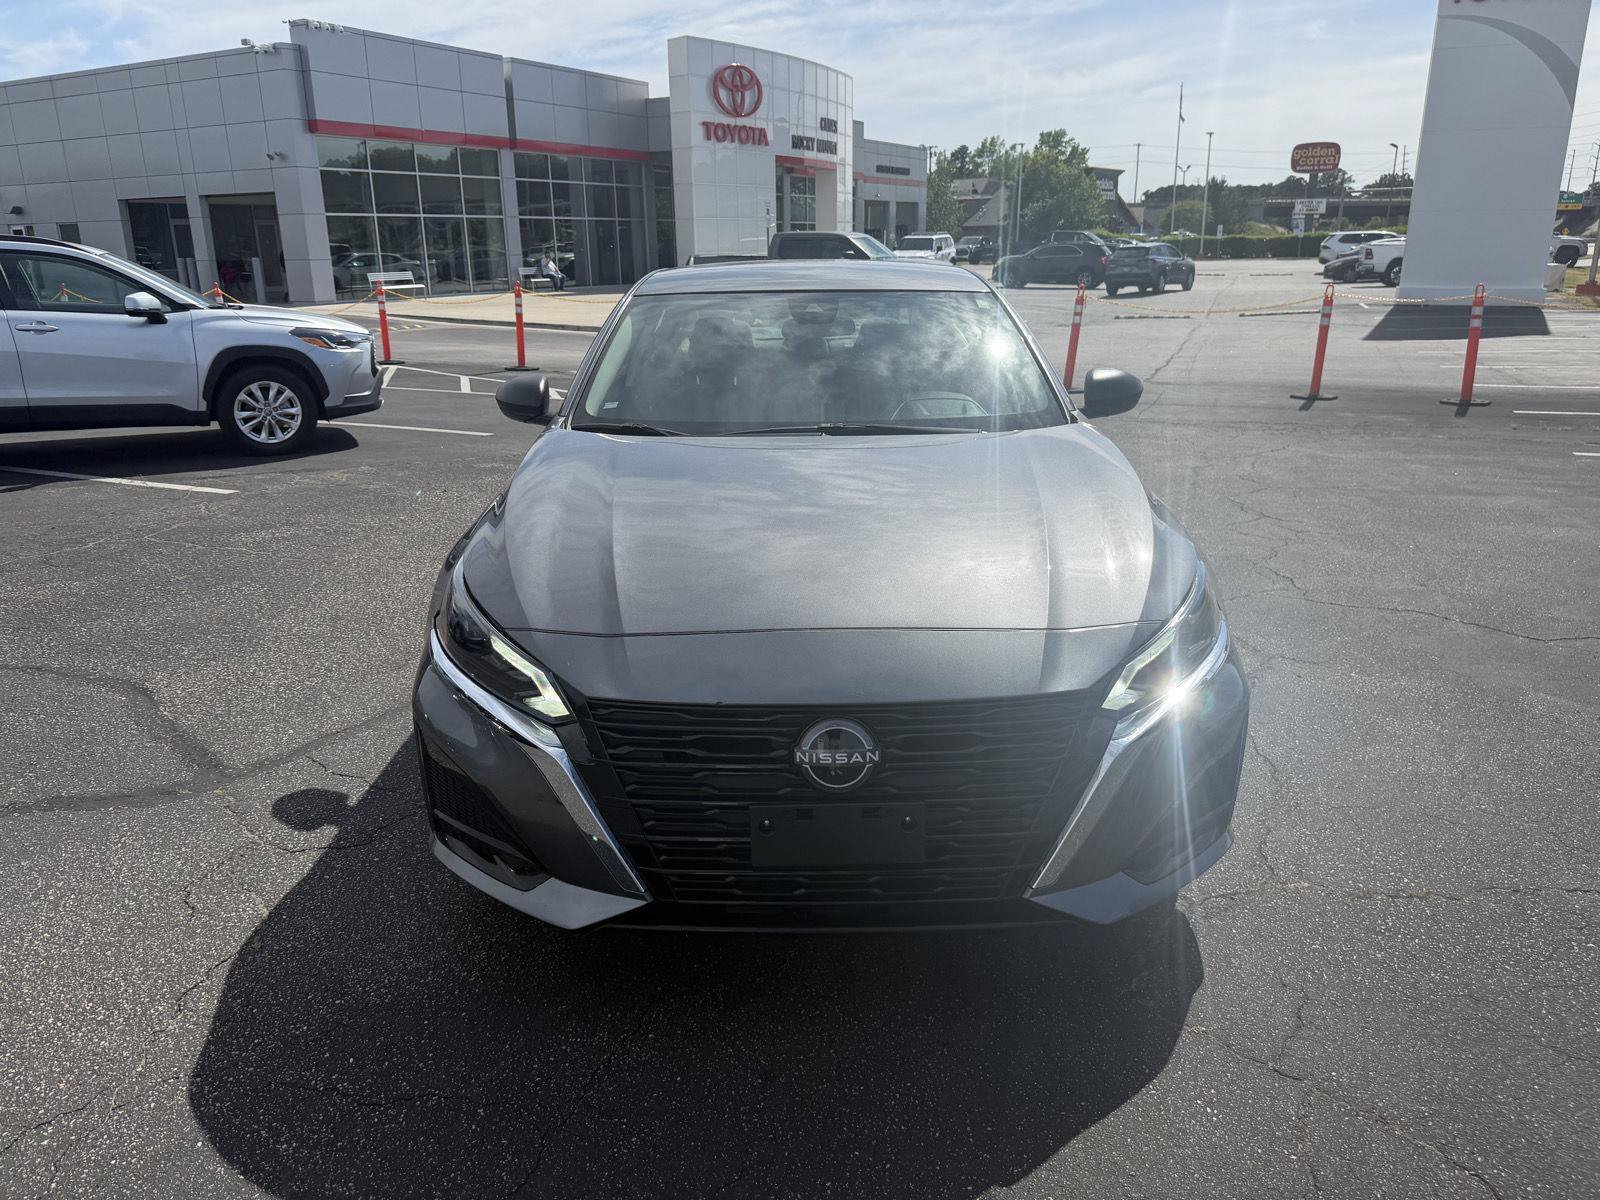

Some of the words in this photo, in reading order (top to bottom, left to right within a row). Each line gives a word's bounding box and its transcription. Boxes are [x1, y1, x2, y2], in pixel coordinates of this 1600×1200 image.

[702, 121, 769, 146] TOYOTA
[791, 134, 815, 151] ROCKY
[1293, 147, 1336, 160] golden
[1299, 154, 1339, 165] corral
[796, 751, 879, 764] NISSAN
